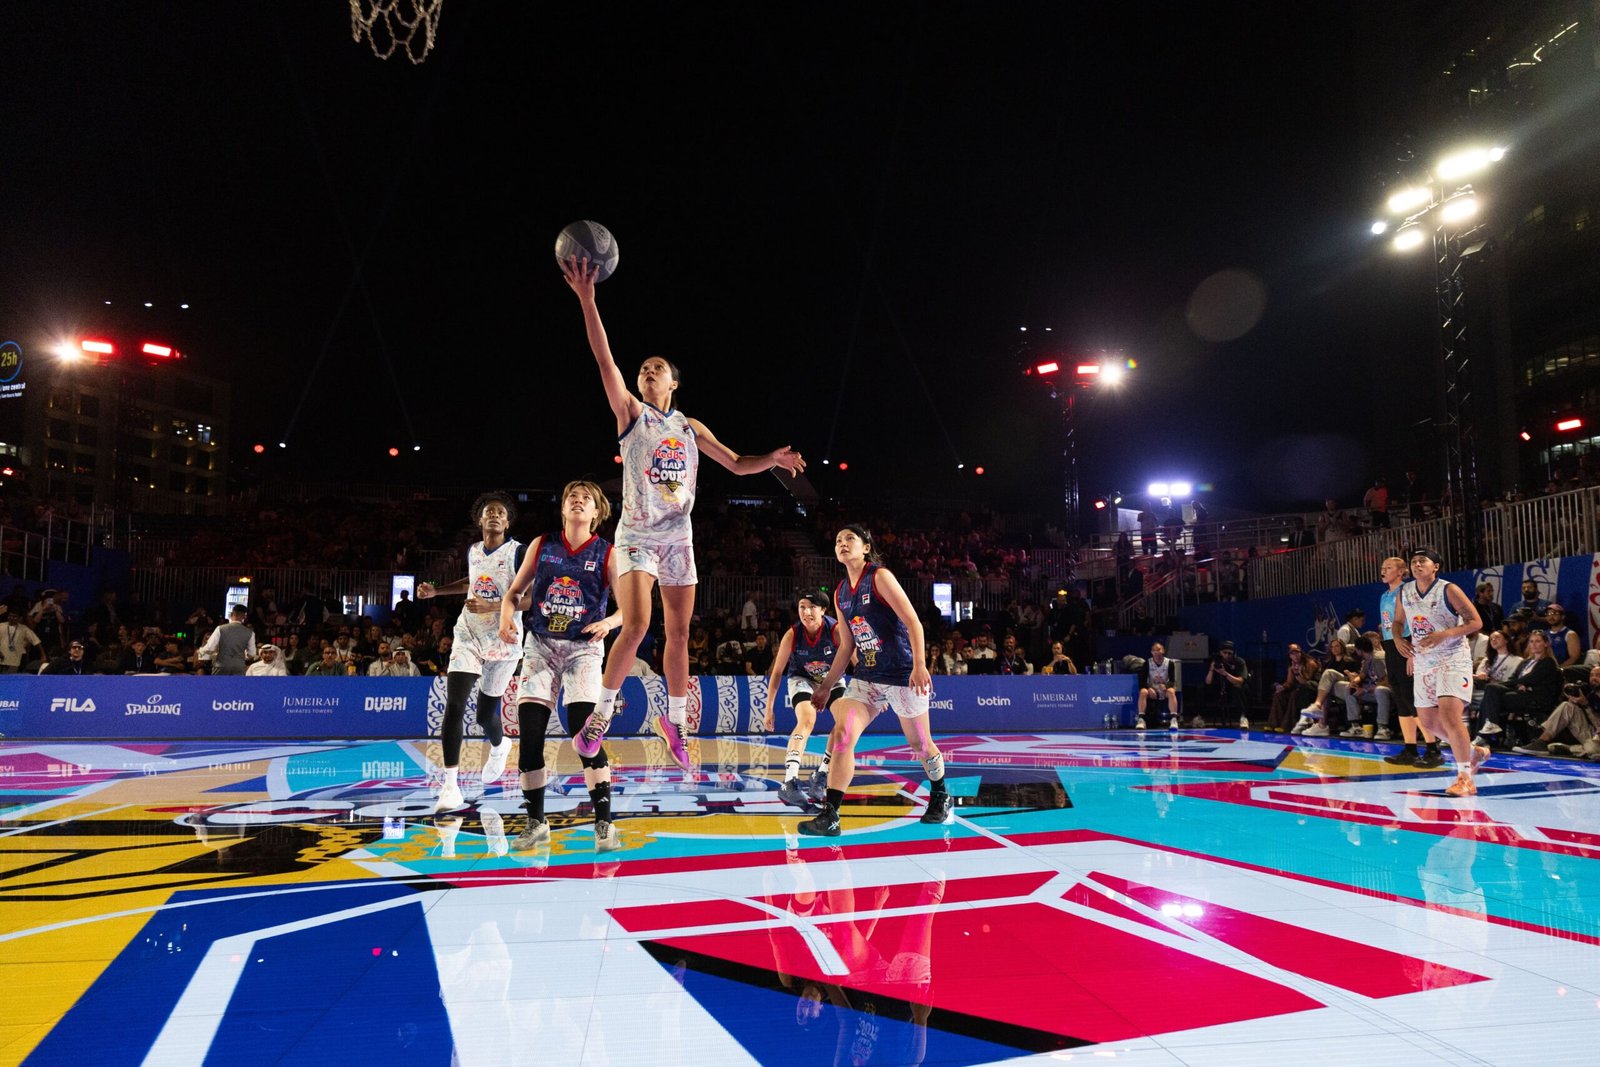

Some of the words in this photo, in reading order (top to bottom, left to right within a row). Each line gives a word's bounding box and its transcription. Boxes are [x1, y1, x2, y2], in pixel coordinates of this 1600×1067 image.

[1, 352, 18, 367] 25h
[553, 597, 574, 605] HALF
[541, 601, 584, 620] COURT
[282, 696, 339, 708] JUMEIRAH
[977, 696, 1011, 706] botim
[1033, 692, 1077, 703] JUMEIRAH
[51, 698, 96, 712] FILA
[125, 703, 181, 716] SPALDING
[212, 700, 254, 711] botim
[364, 696, 407, 713] DUBAI
